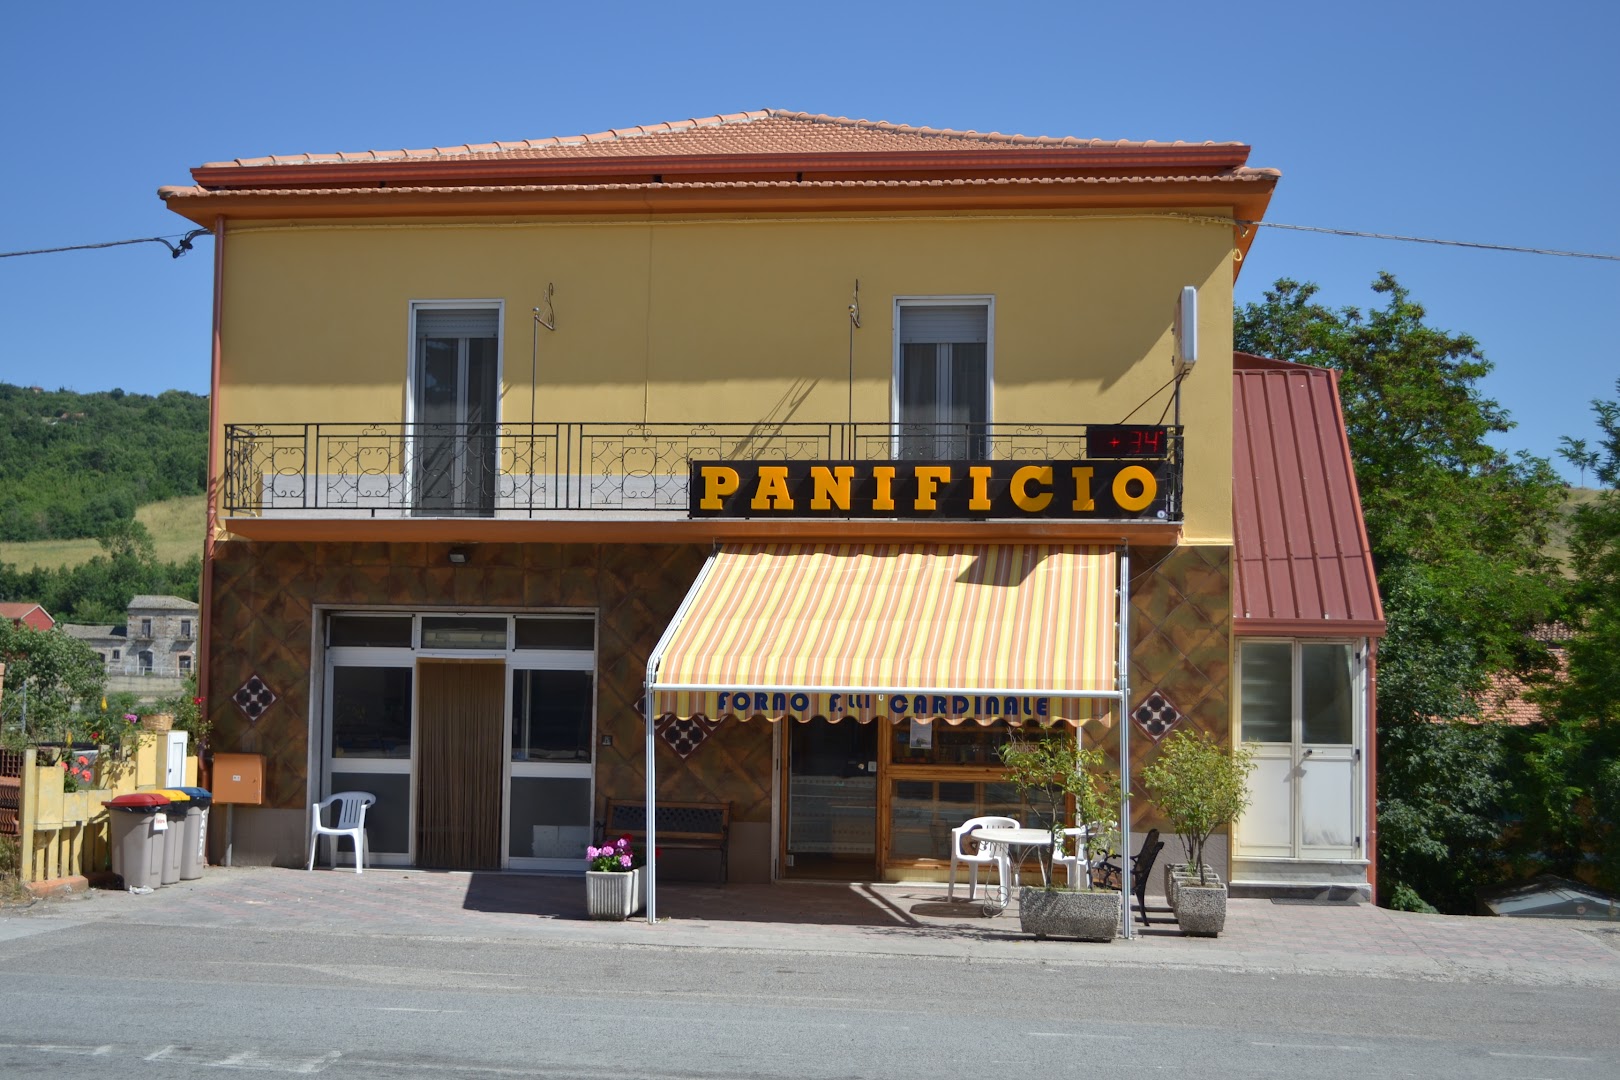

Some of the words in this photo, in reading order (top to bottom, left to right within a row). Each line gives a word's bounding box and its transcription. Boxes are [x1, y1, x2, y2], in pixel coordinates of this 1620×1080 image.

[700, 465, 1158, 512] PANIFICIO
[718, 691, 810, 712] FORNO
[890, 694, 1048, 716] CARDINALE
